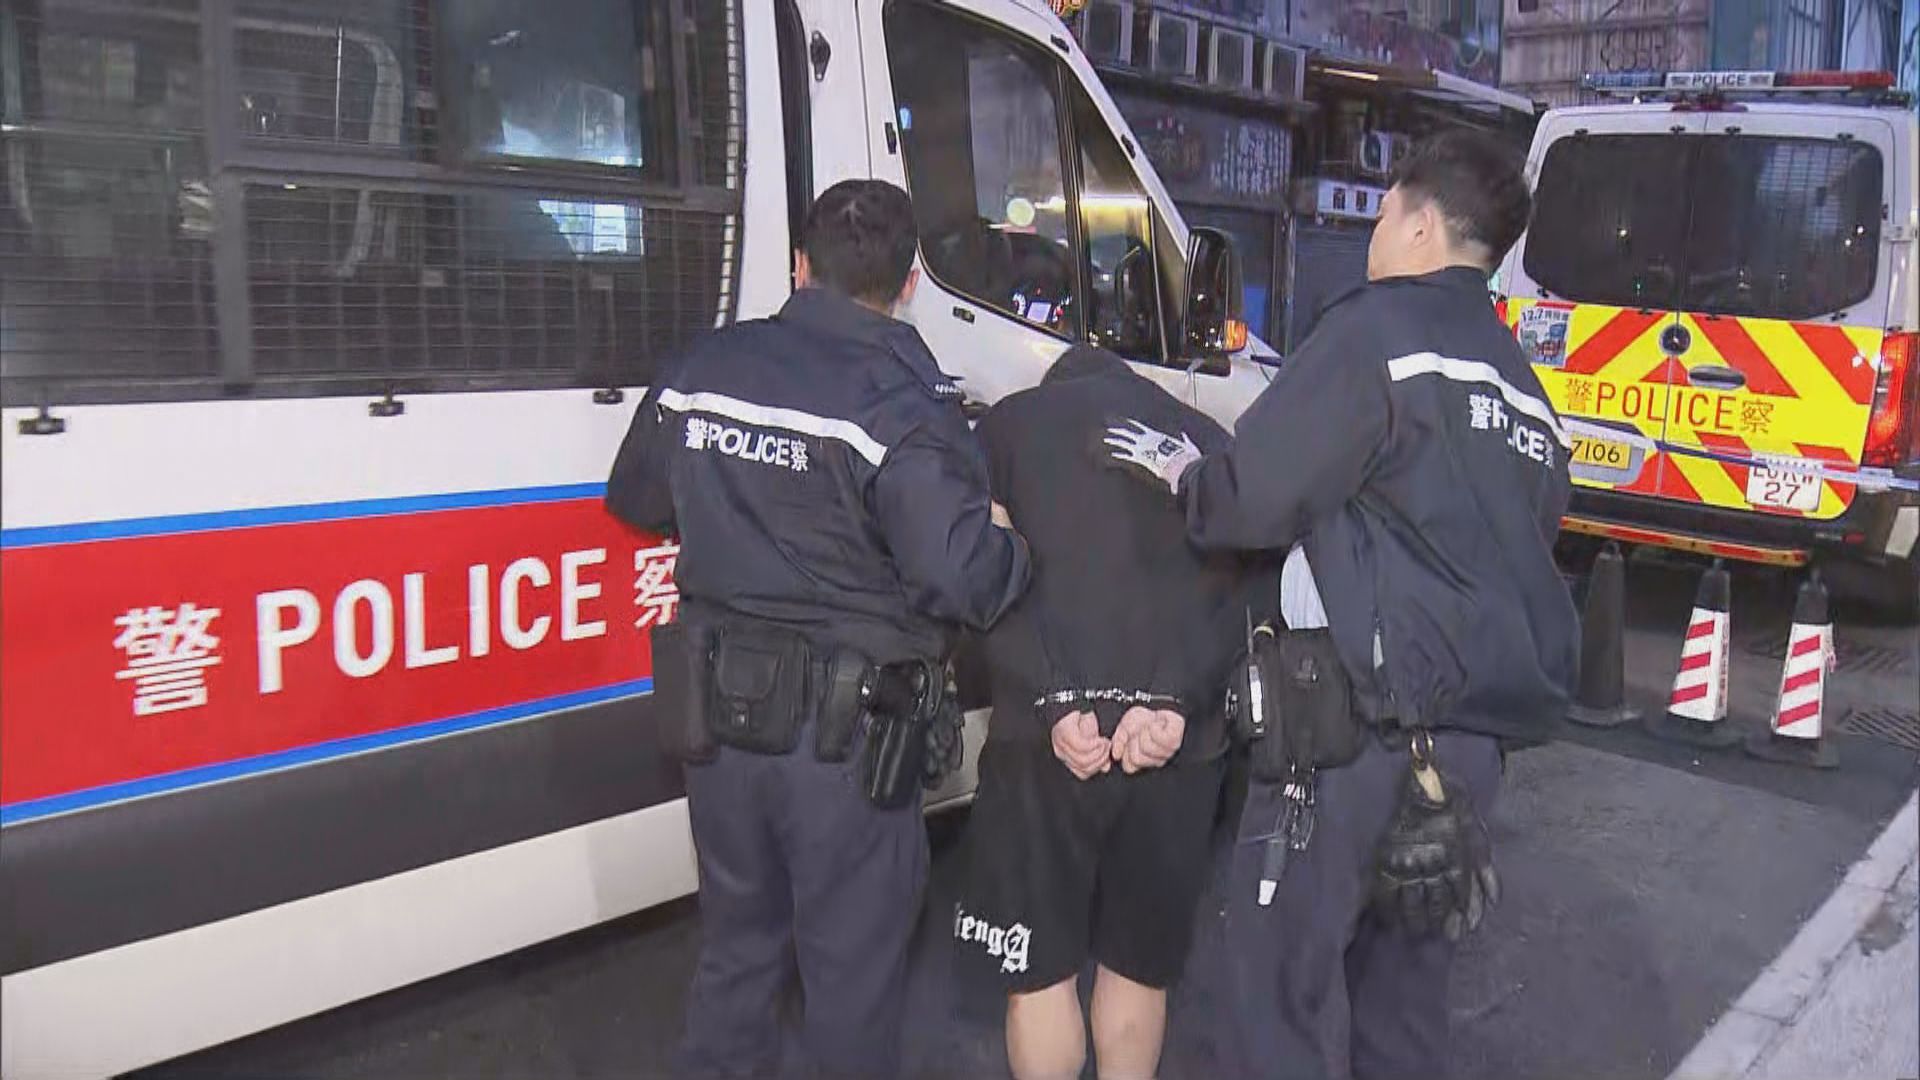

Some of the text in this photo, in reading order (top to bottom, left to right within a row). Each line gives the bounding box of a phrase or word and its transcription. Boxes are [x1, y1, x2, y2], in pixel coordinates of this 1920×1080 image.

[1692, 74, 1746, 87] POLICE
[1569, 440, 1620, 464] 7106
[1763, 481, 1801, 504] 27
[114, 601, 222, 716] 警
[256, 547, 608, 694] POLICE
